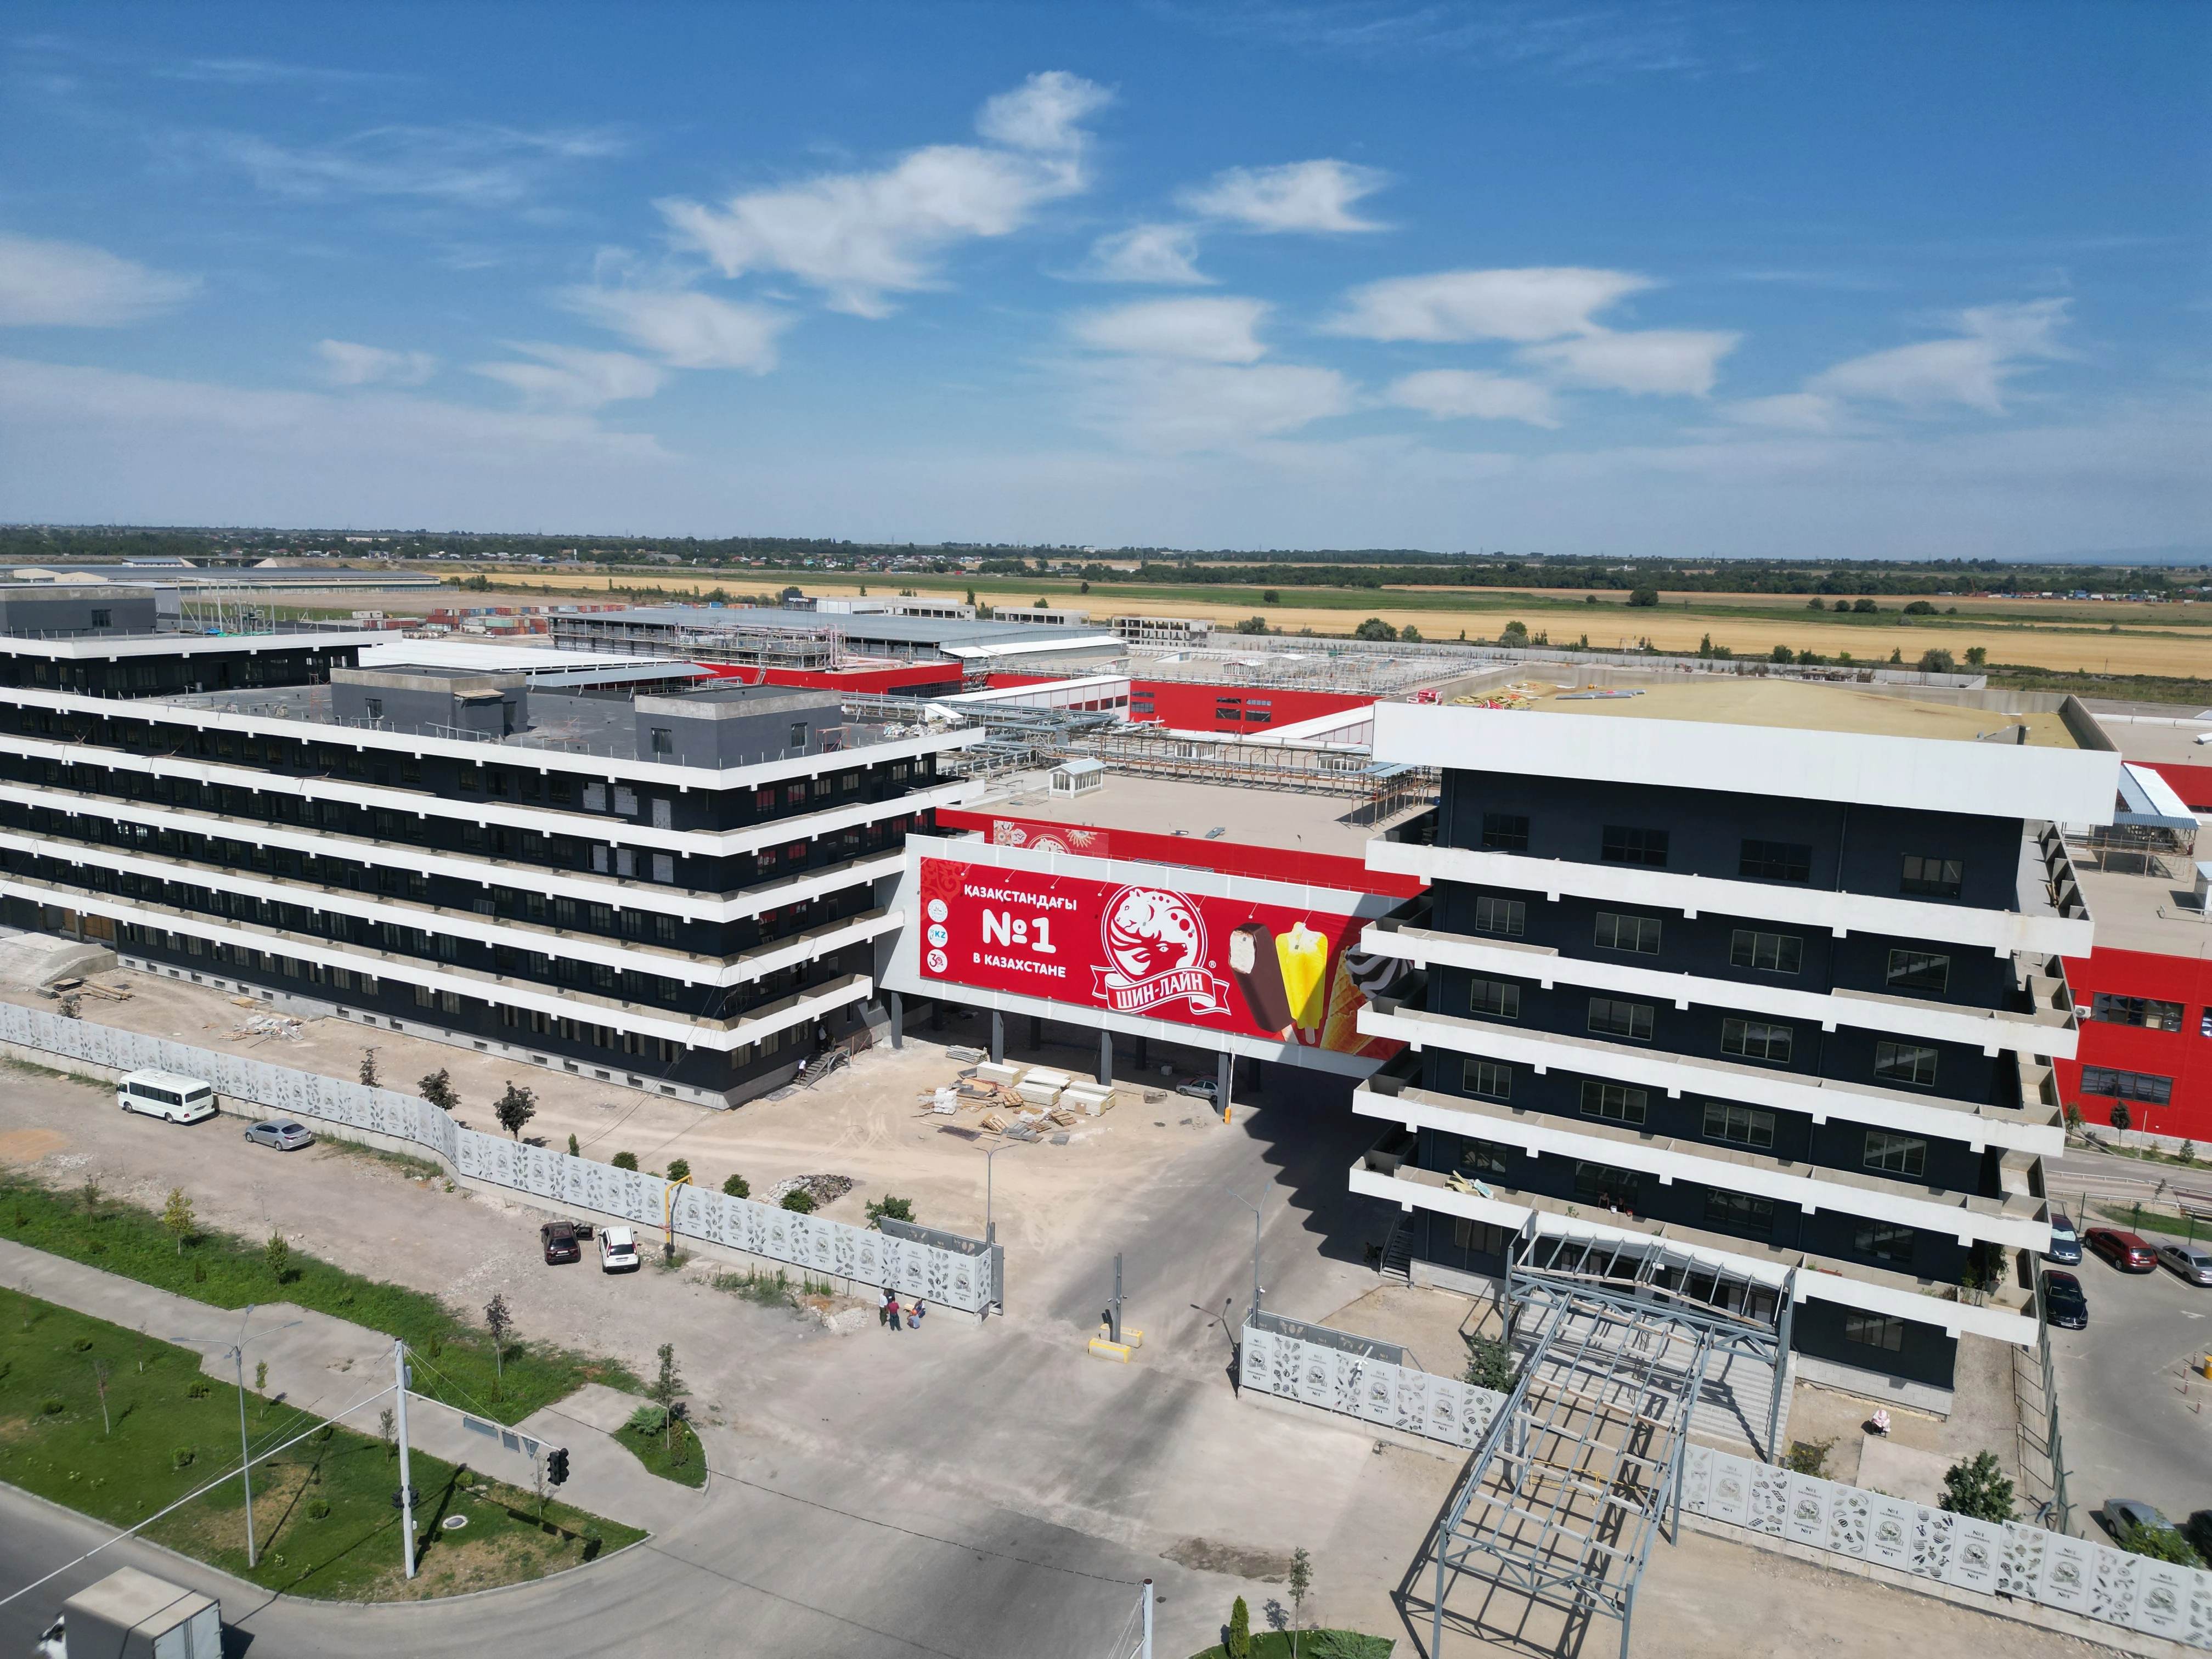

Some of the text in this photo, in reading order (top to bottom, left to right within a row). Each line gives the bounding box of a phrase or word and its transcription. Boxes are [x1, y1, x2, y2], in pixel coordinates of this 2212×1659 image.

[964, 884, 1077, 911] ҚАЗАҚСТАНДАҒЫ
[973, 952, 1066, 978] В КАЗАХСТАНЕ
[1116, 971, 1204, 1009] ШИН-ЛАЙН
